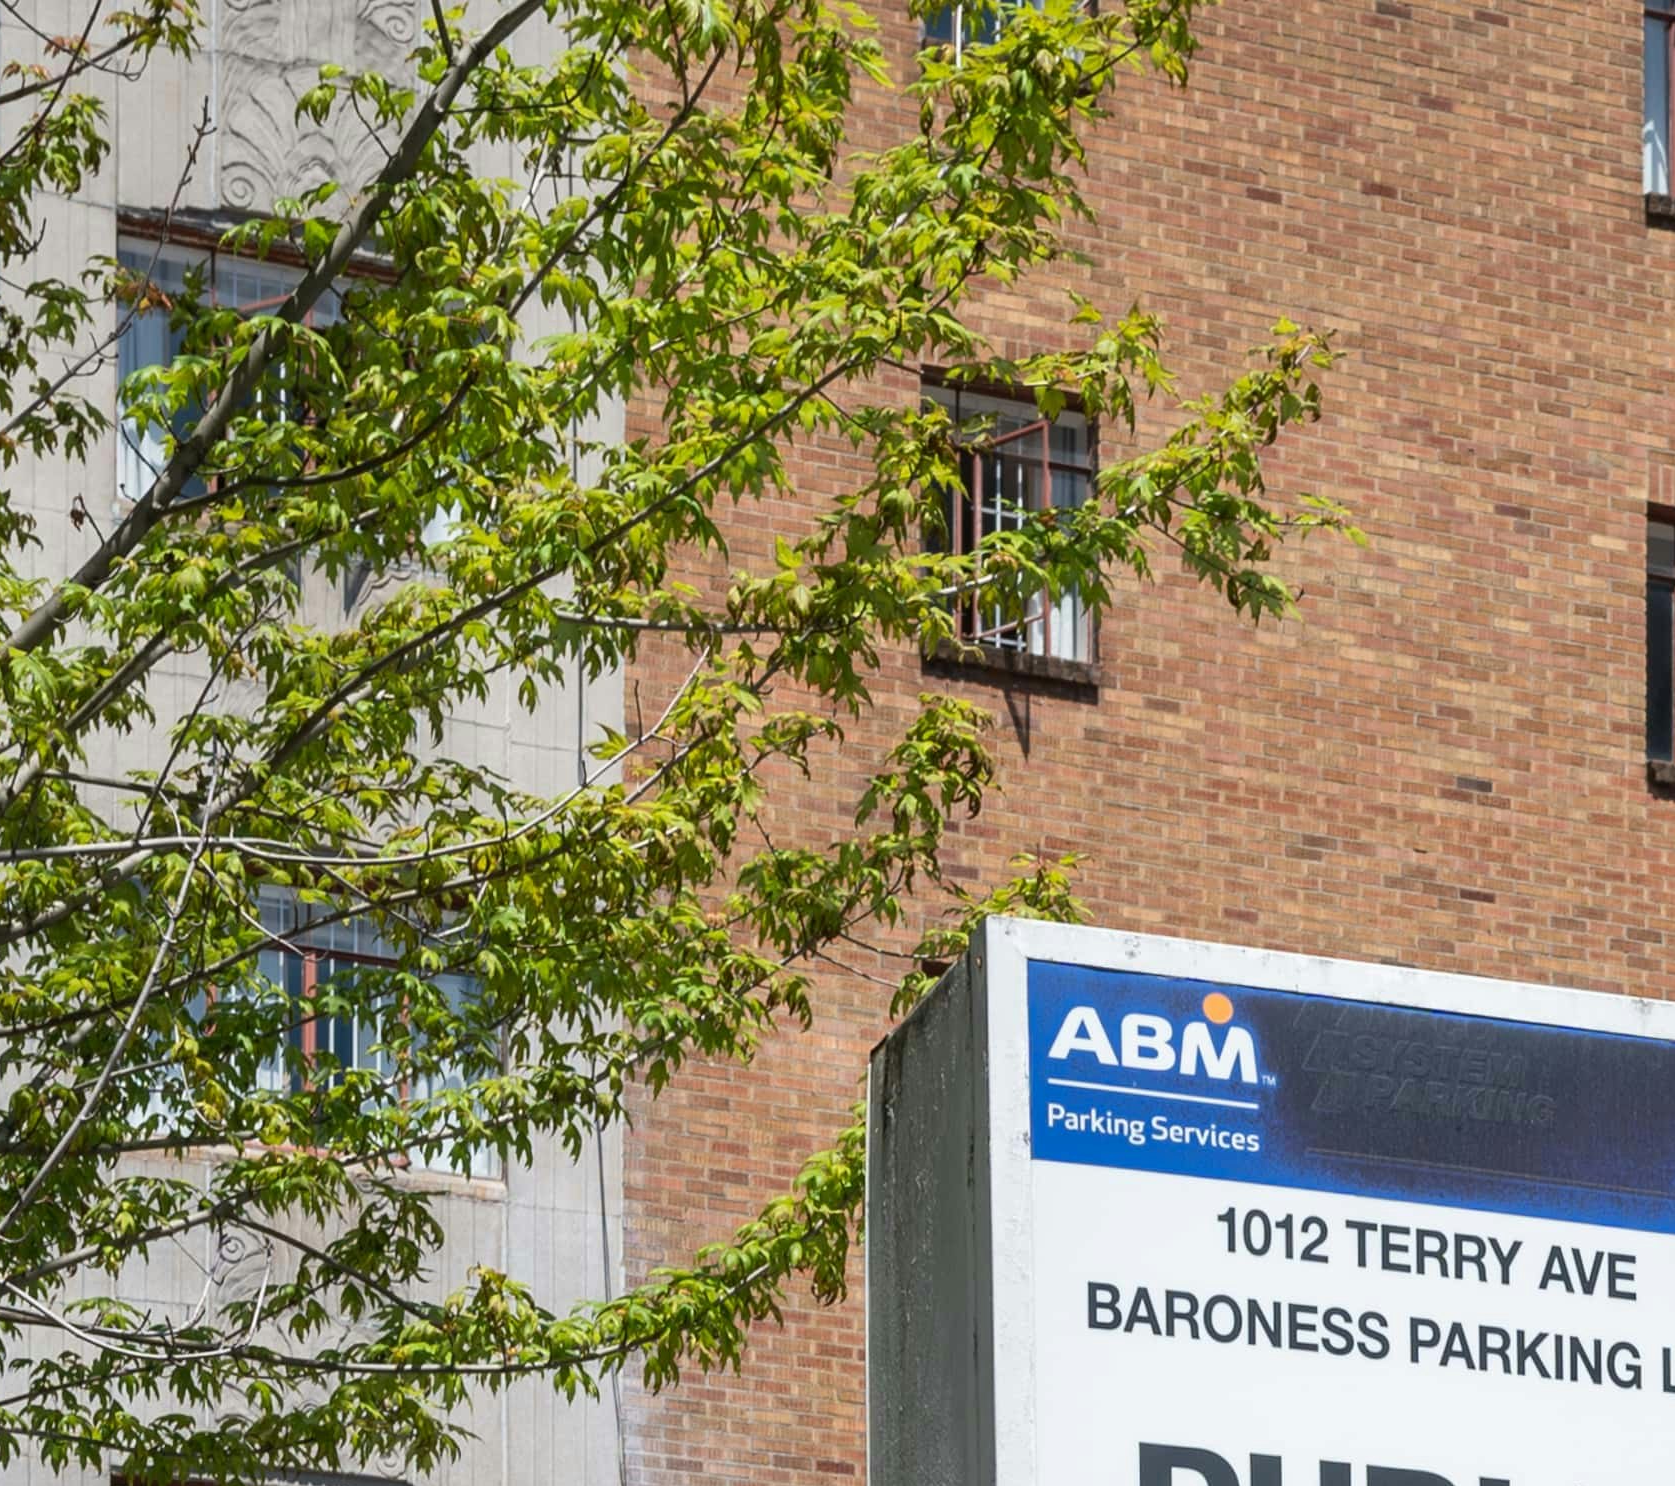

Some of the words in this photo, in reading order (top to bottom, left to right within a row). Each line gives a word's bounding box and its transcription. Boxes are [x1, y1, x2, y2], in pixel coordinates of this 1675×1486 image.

[1048, 1006, 1258, 1083] ABM
[1048, 1103, 1146, 1144] Parking
[1152, 1116, 1260, 1152] Services
[1218, 1208, 1328, 1263] 1012
[1346, 1220, 1522, 1284] TERRY
[1539, 1246, 1636, 1300] AVE
[1088, 1282, 1389, 1359] BARONESS
[1410, 1317, 1641, 1389] PARKING
